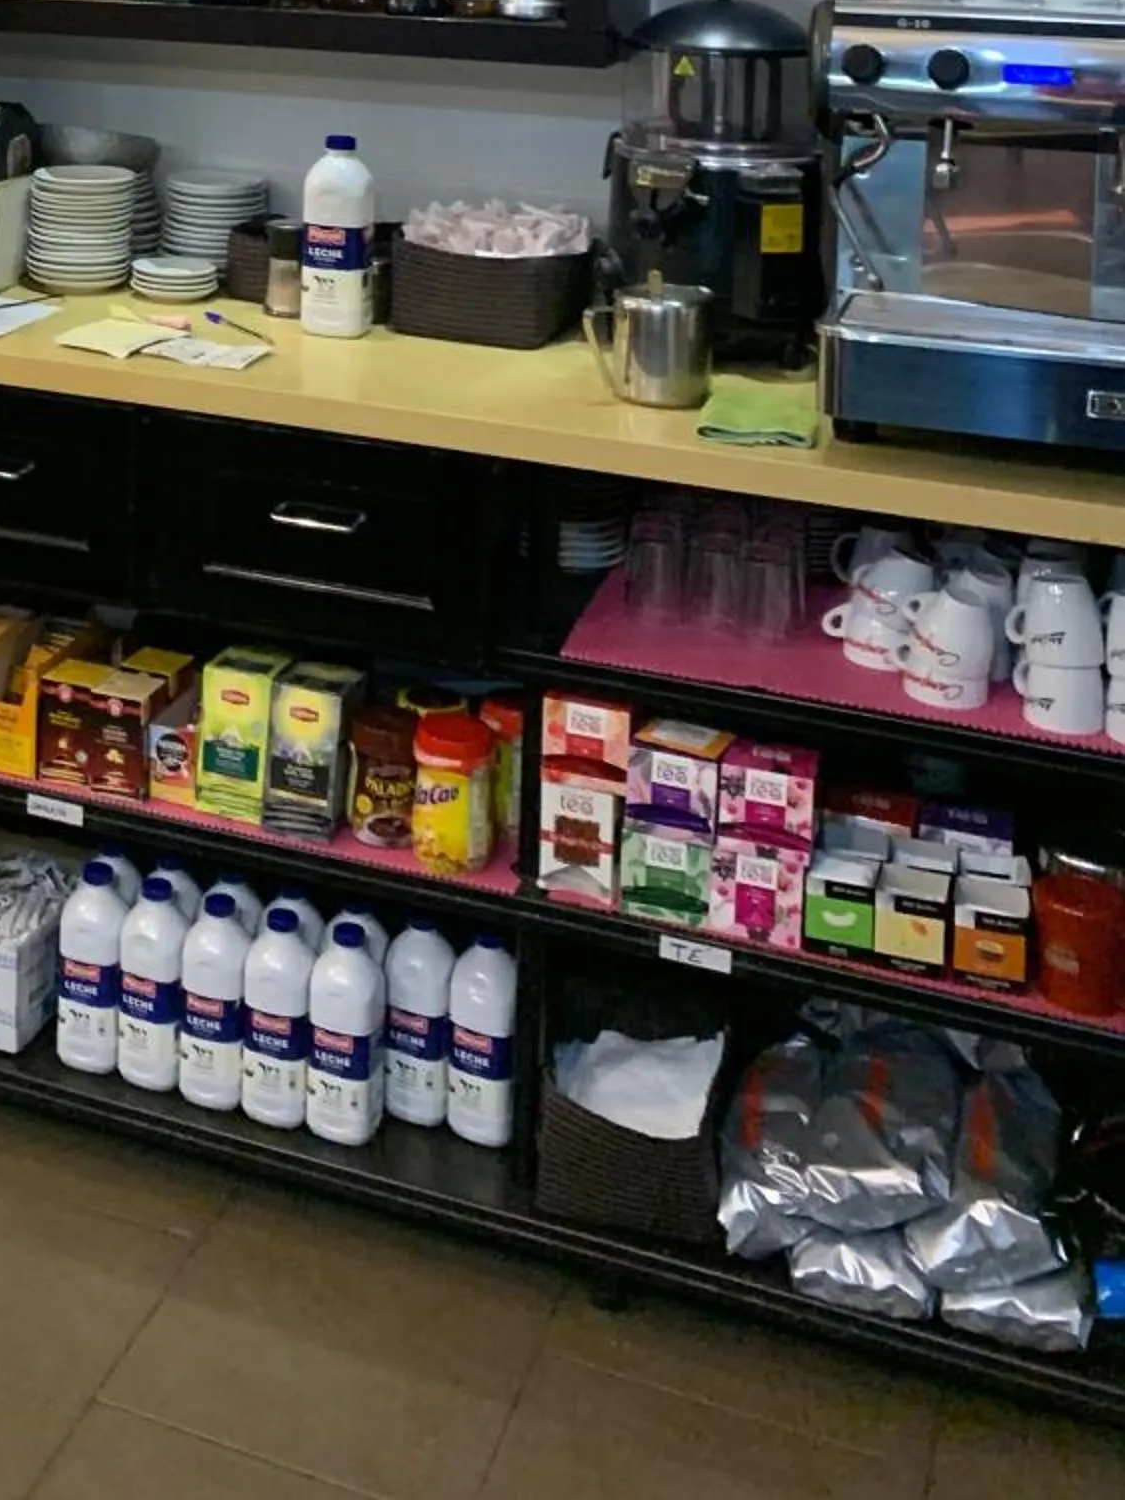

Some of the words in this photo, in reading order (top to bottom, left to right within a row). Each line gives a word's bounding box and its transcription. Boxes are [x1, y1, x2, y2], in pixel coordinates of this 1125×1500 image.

[307, 246, 344, 260] LECHE
[560, 794, 594, 816] tea
[64, 979, 99, 997] LECHE
[122, 994, 155, 1013] LECHE
[186, 1014, 222, 1032] LECHE
[252, 1032, 289, 1050] LECHE
[389, 1029, 426, 1049] LECHE
[314, 1050, 351, 1068] LECHE
[454, 1047, 491, 1068] LECHE
